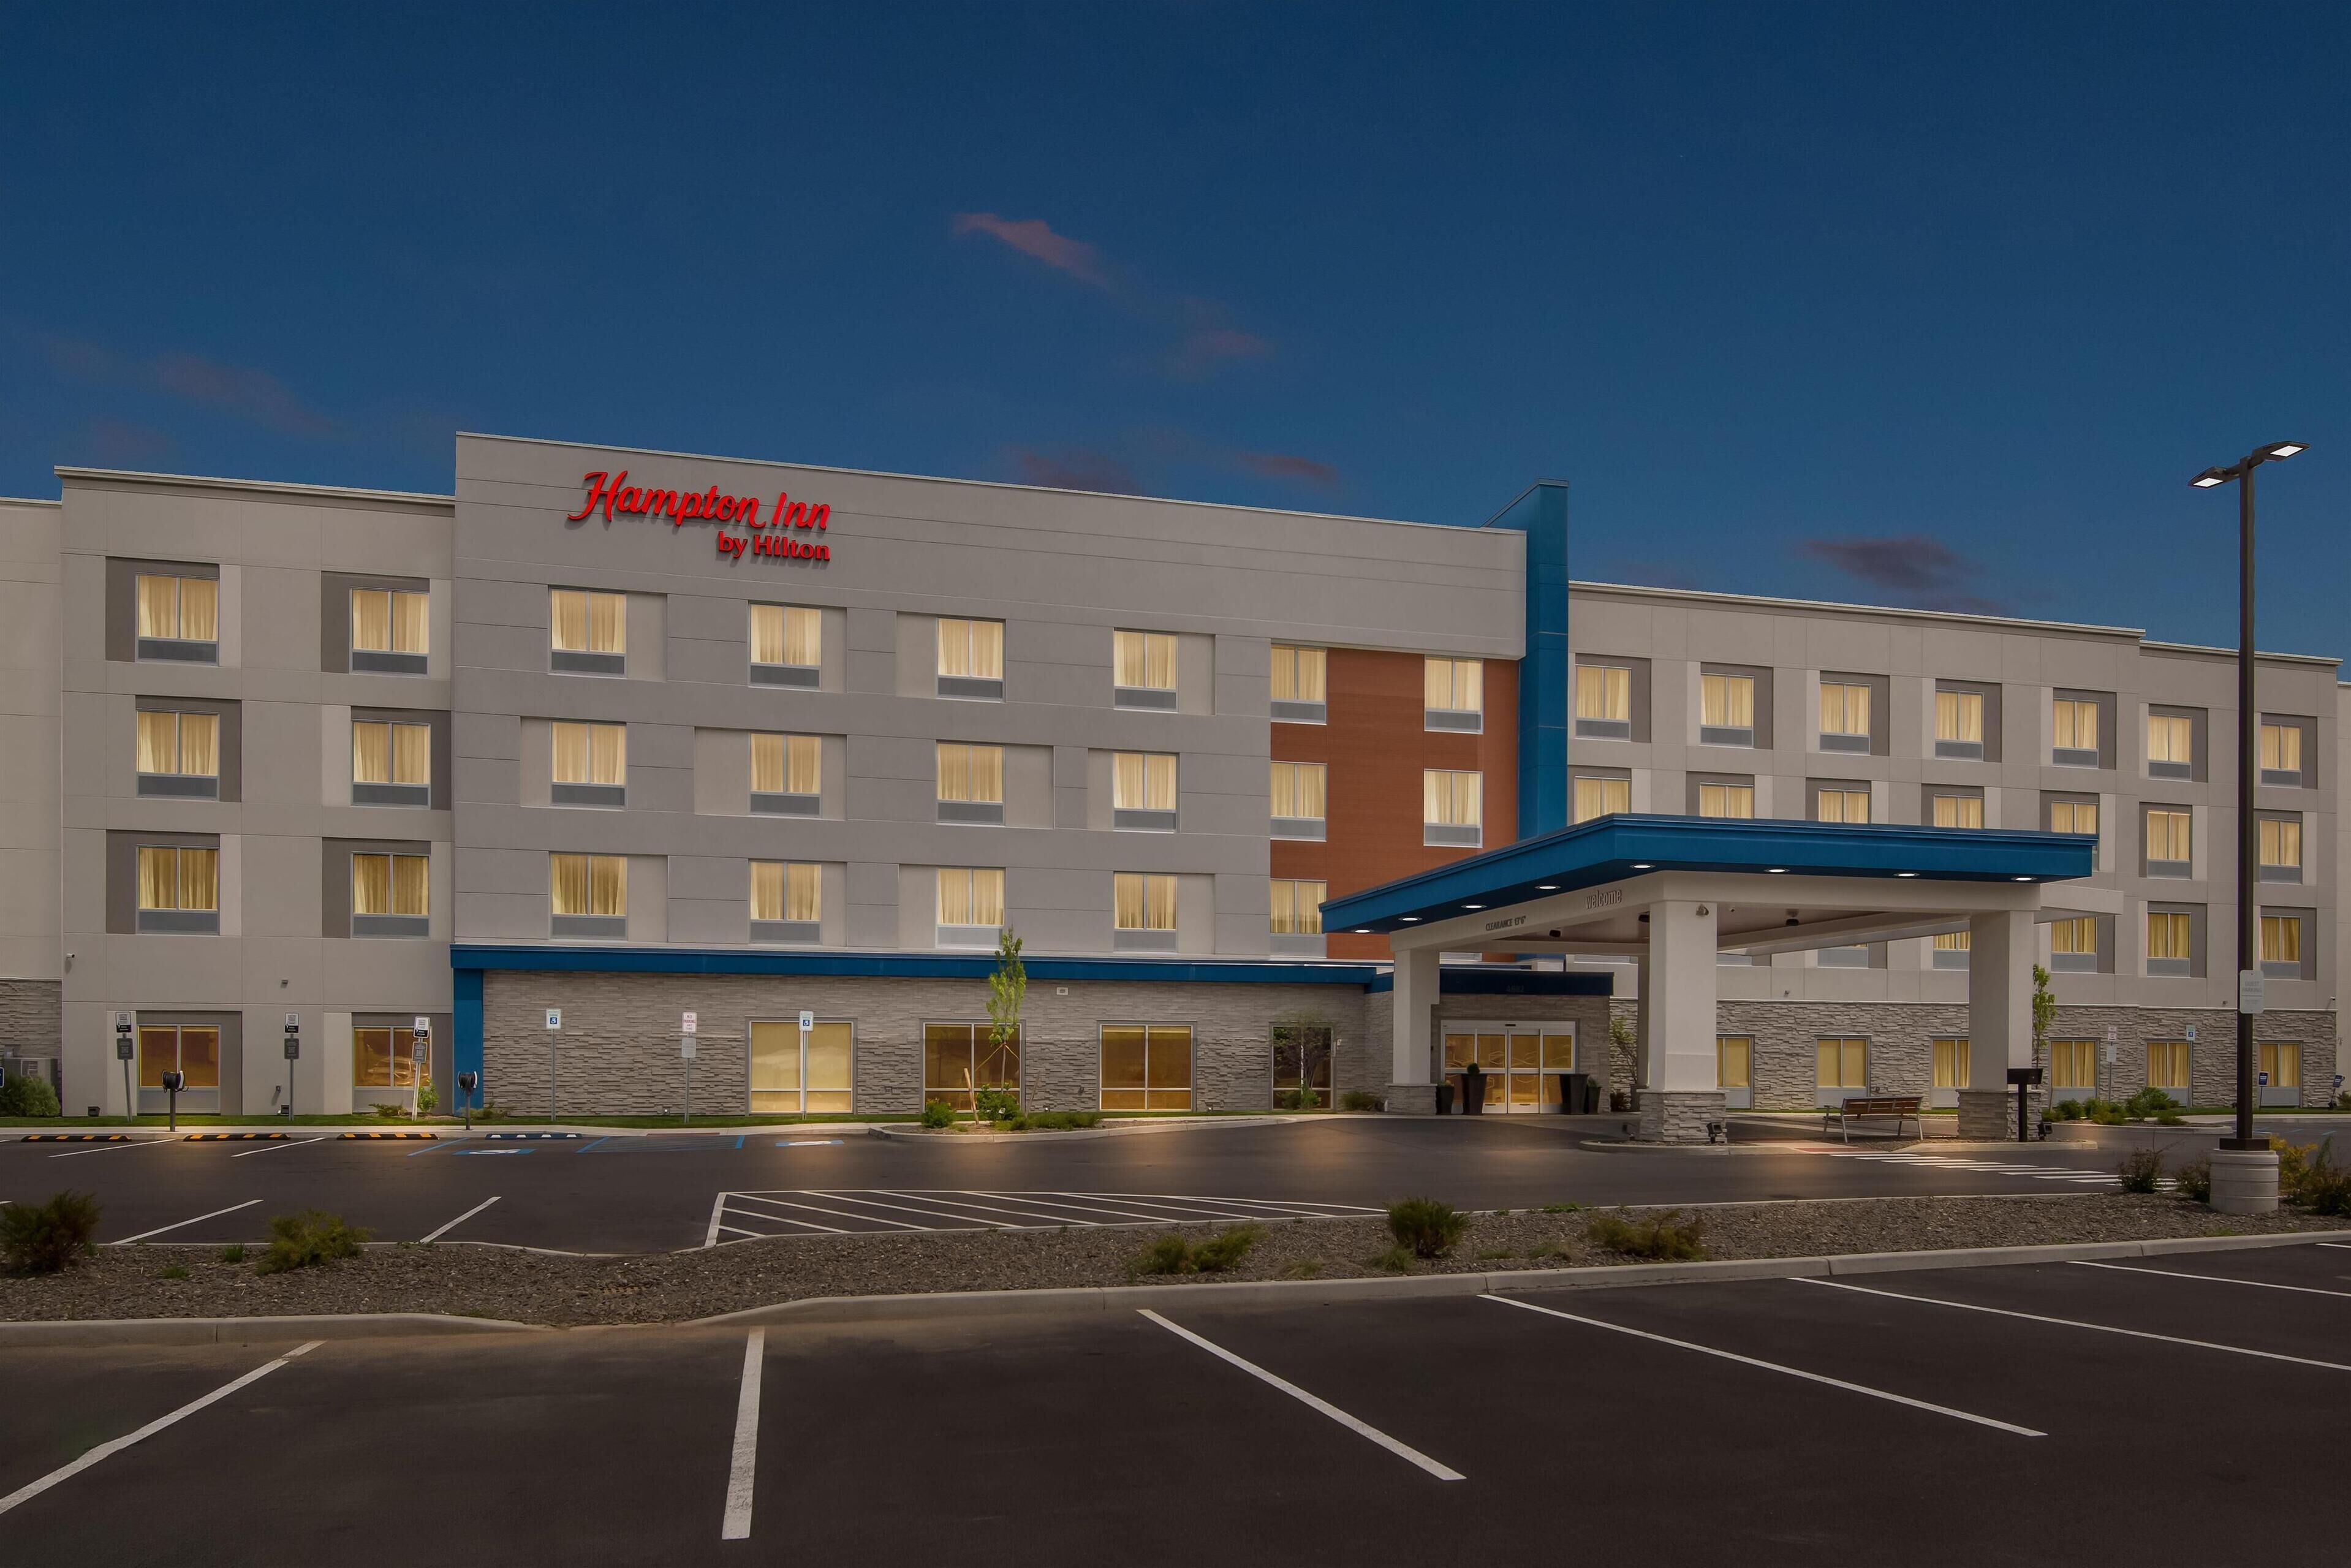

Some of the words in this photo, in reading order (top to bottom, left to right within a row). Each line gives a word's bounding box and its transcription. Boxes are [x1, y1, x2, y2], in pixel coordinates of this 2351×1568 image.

[567, 470, 766, 528] Hampton
[771, 491, 831, 529] Inn
[717, 531, 748, 559] by
[754, 534, 830, 561] Hilton
[1584, 890, 1622, 909] welcome
[1485, 918, 1513, 931] CLEARANCE
